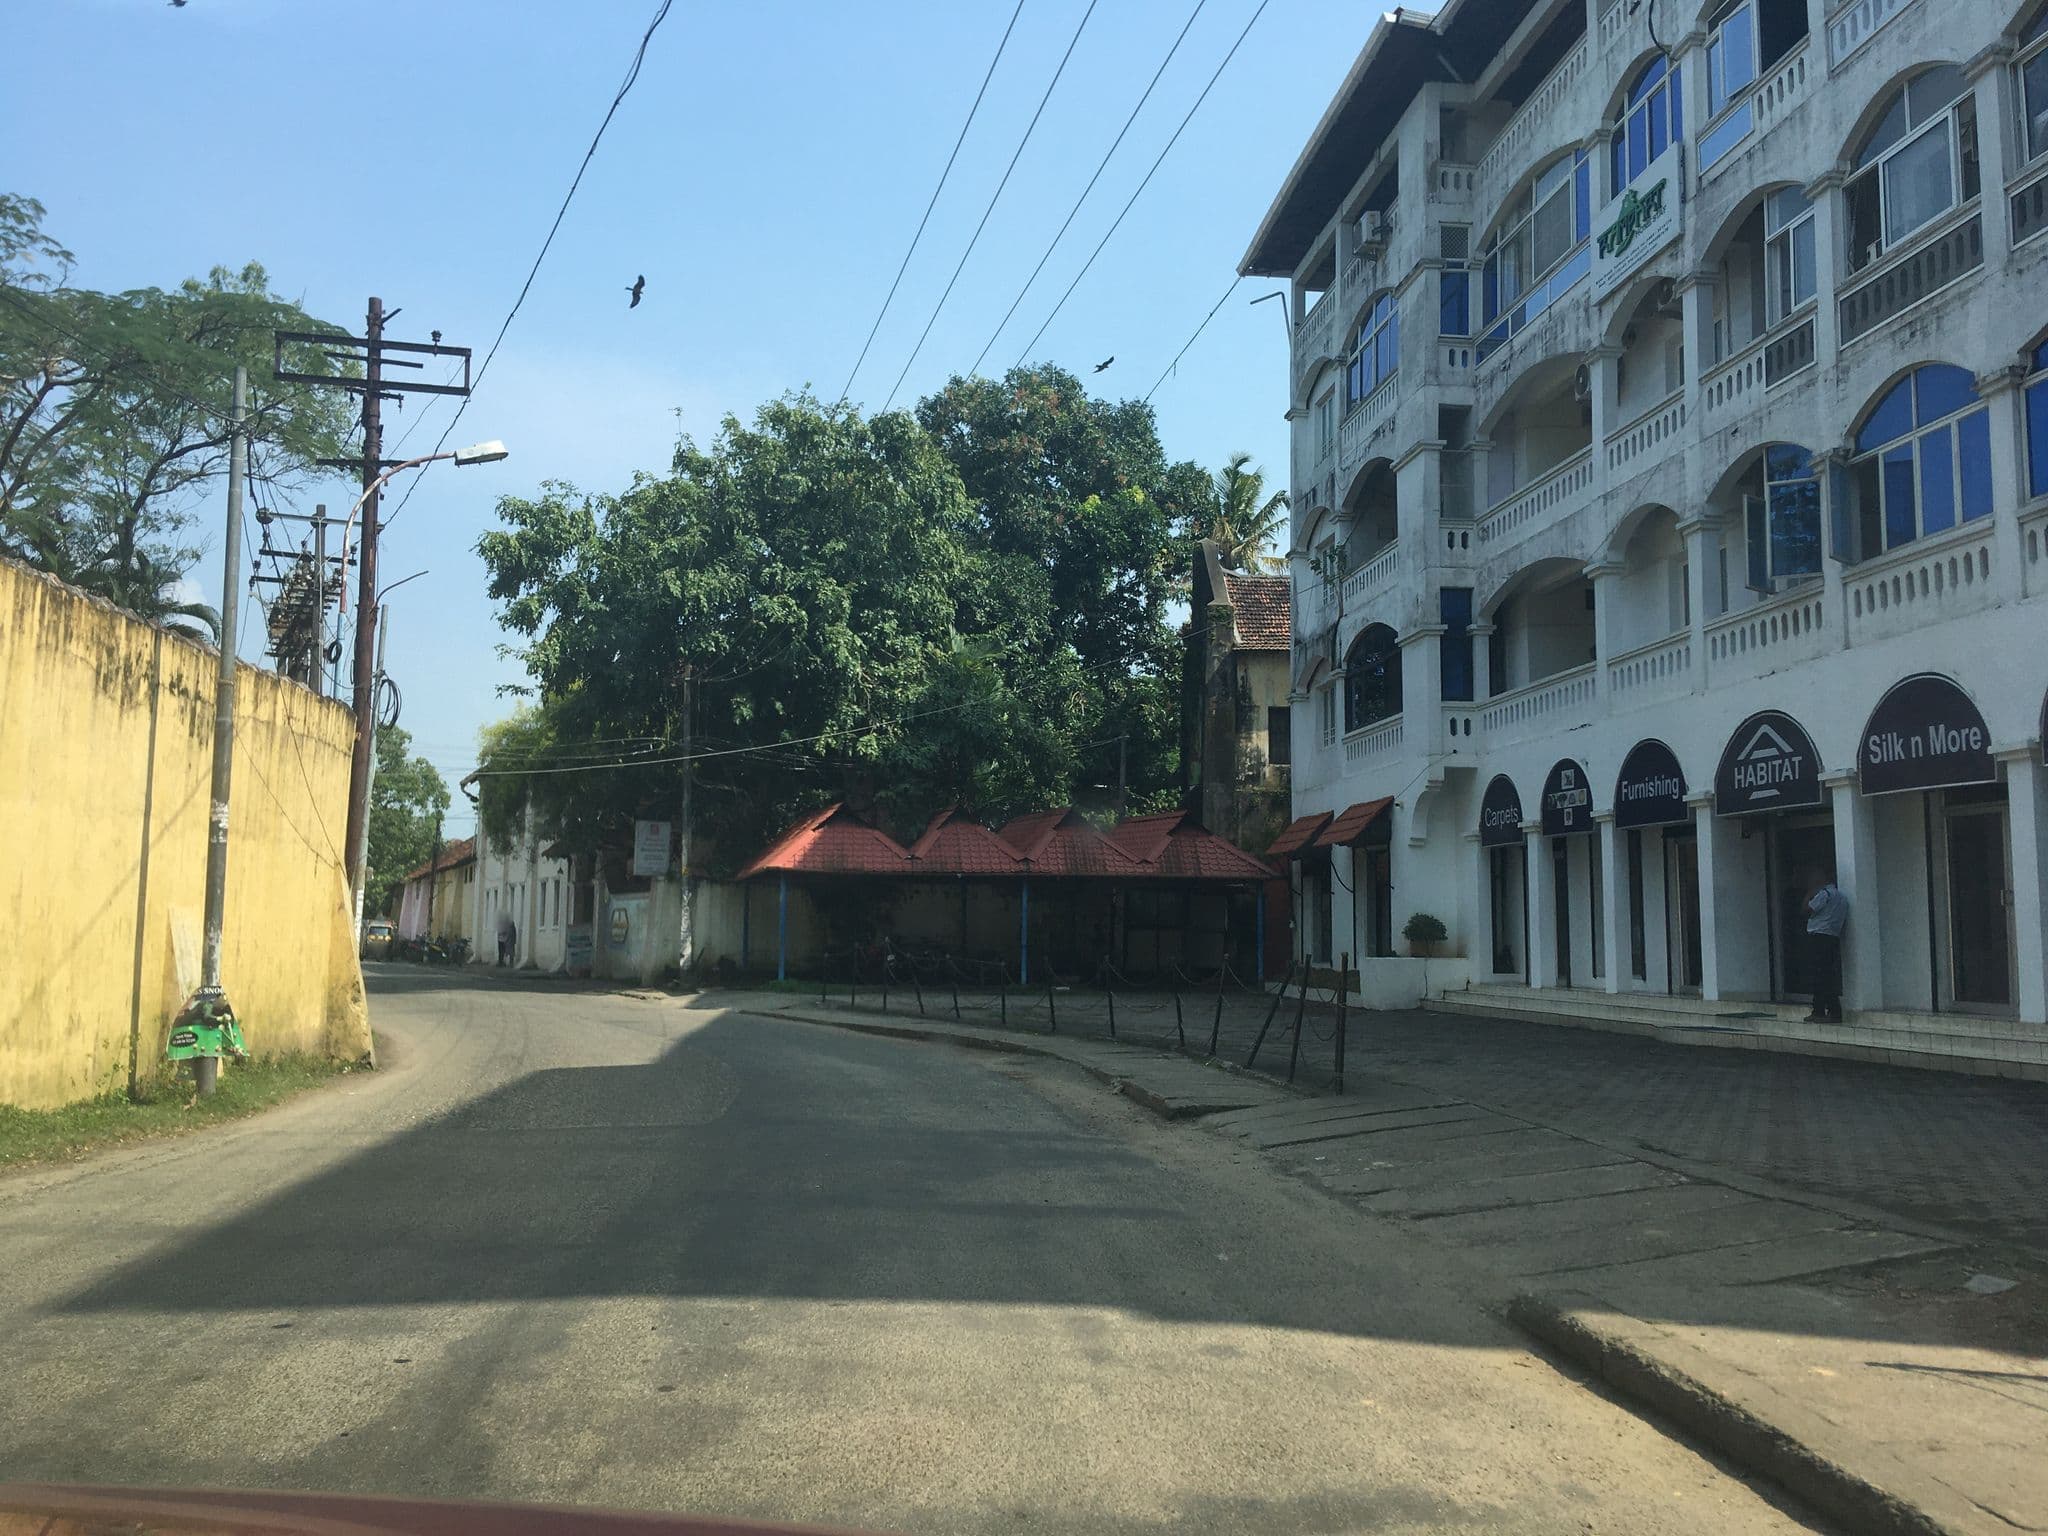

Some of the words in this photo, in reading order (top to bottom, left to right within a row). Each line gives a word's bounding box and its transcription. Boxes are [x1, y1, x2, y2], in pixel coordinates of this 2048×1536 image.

[1869, 731, 1905, 764] Silk
[1911, 735, 1923, 758] n
[1928, 724, 1982, 755] More
[1734, 755, 1804, 789] HABITAT
[1621, 775, 1680, 801] Furnishing
[1484, 804, 1519, 830] Carpets
